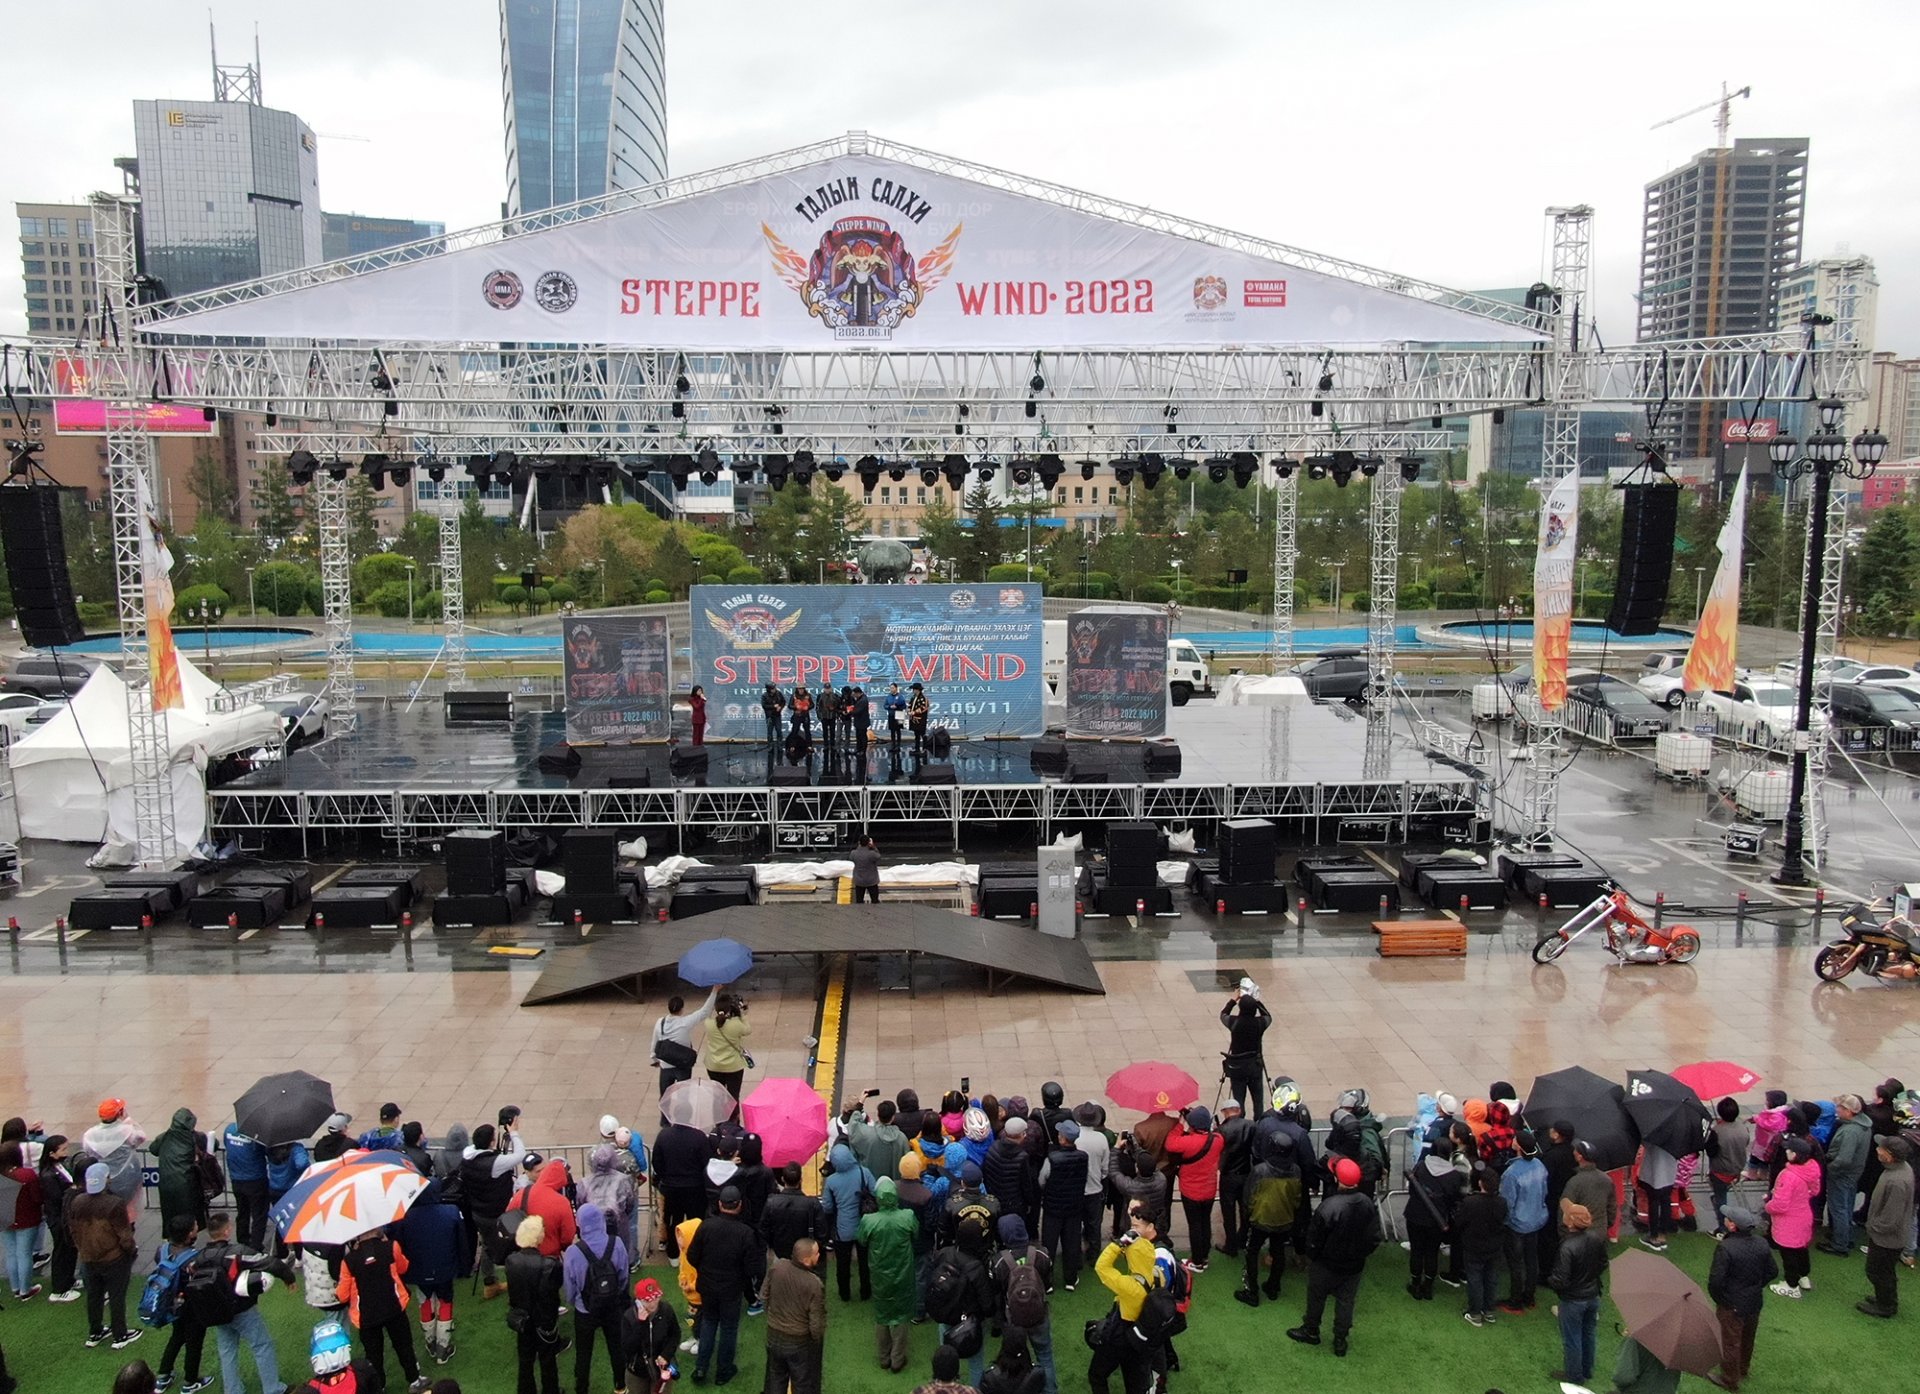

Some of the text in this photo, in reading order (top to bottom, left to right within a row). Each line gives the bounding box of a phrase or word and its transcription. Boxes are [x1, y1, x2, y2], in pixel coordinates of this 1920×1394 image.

[795, 177, 932, 224] ТАЛЫН САЛХИ
[836, 220, 886, 232] STEPPE WIND
[495, 285, 512, 294] MMA
[1255, 282, 1284, 291] YAMAHA
[620, 279, 760, 317] STEPPE
[838, 327, 890, 337] 2022.06.11
[713, 653, 1026, 684] STEPPE WIND
